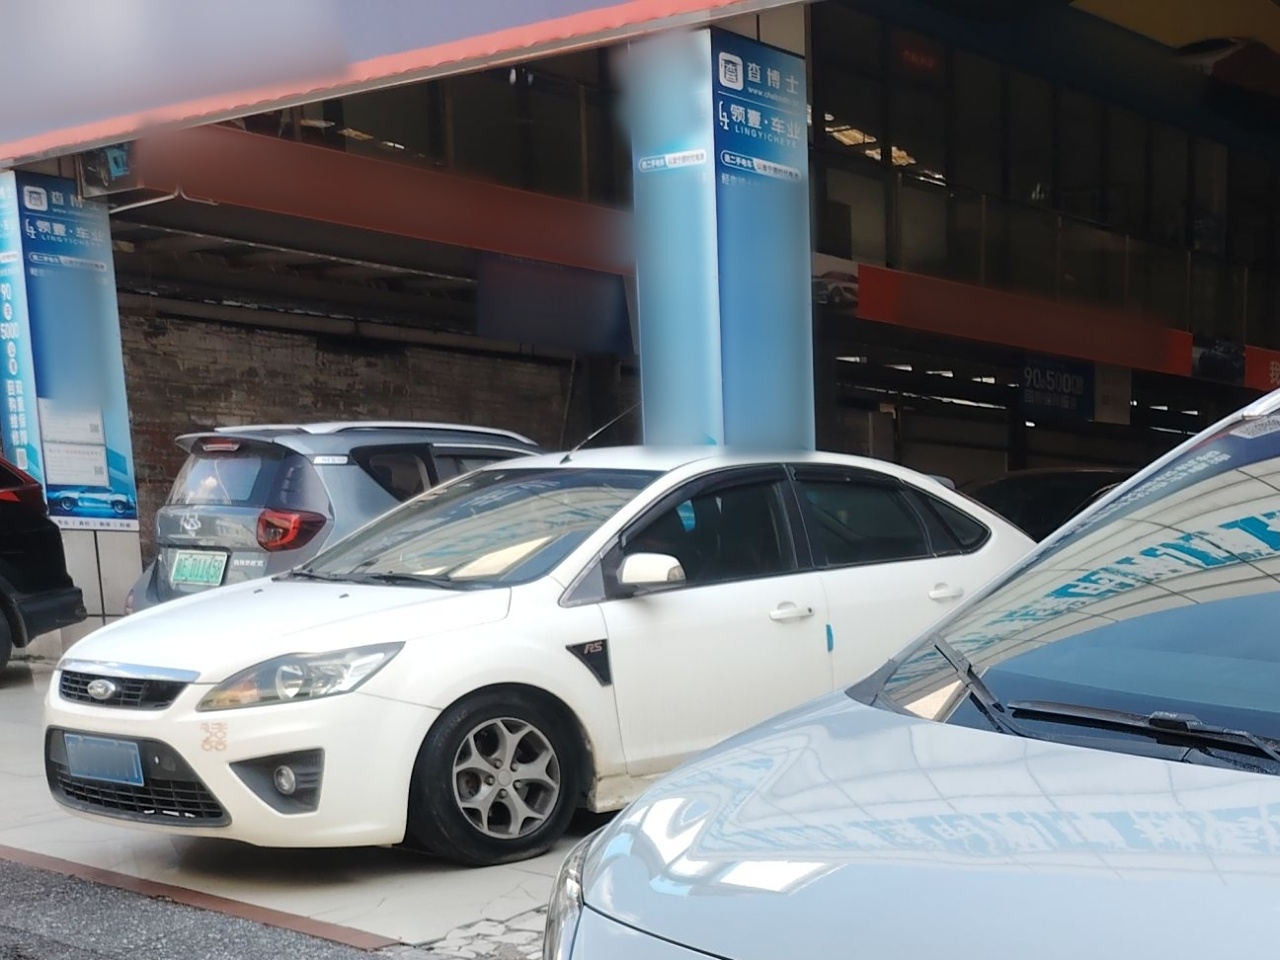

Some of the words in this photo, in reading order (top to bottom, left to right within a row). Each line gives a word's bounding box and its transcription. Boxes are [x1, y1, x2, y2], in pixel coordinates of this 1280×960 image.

[747, 62, 799, 94] 查博士
[584, 641, 603, 654] RS
